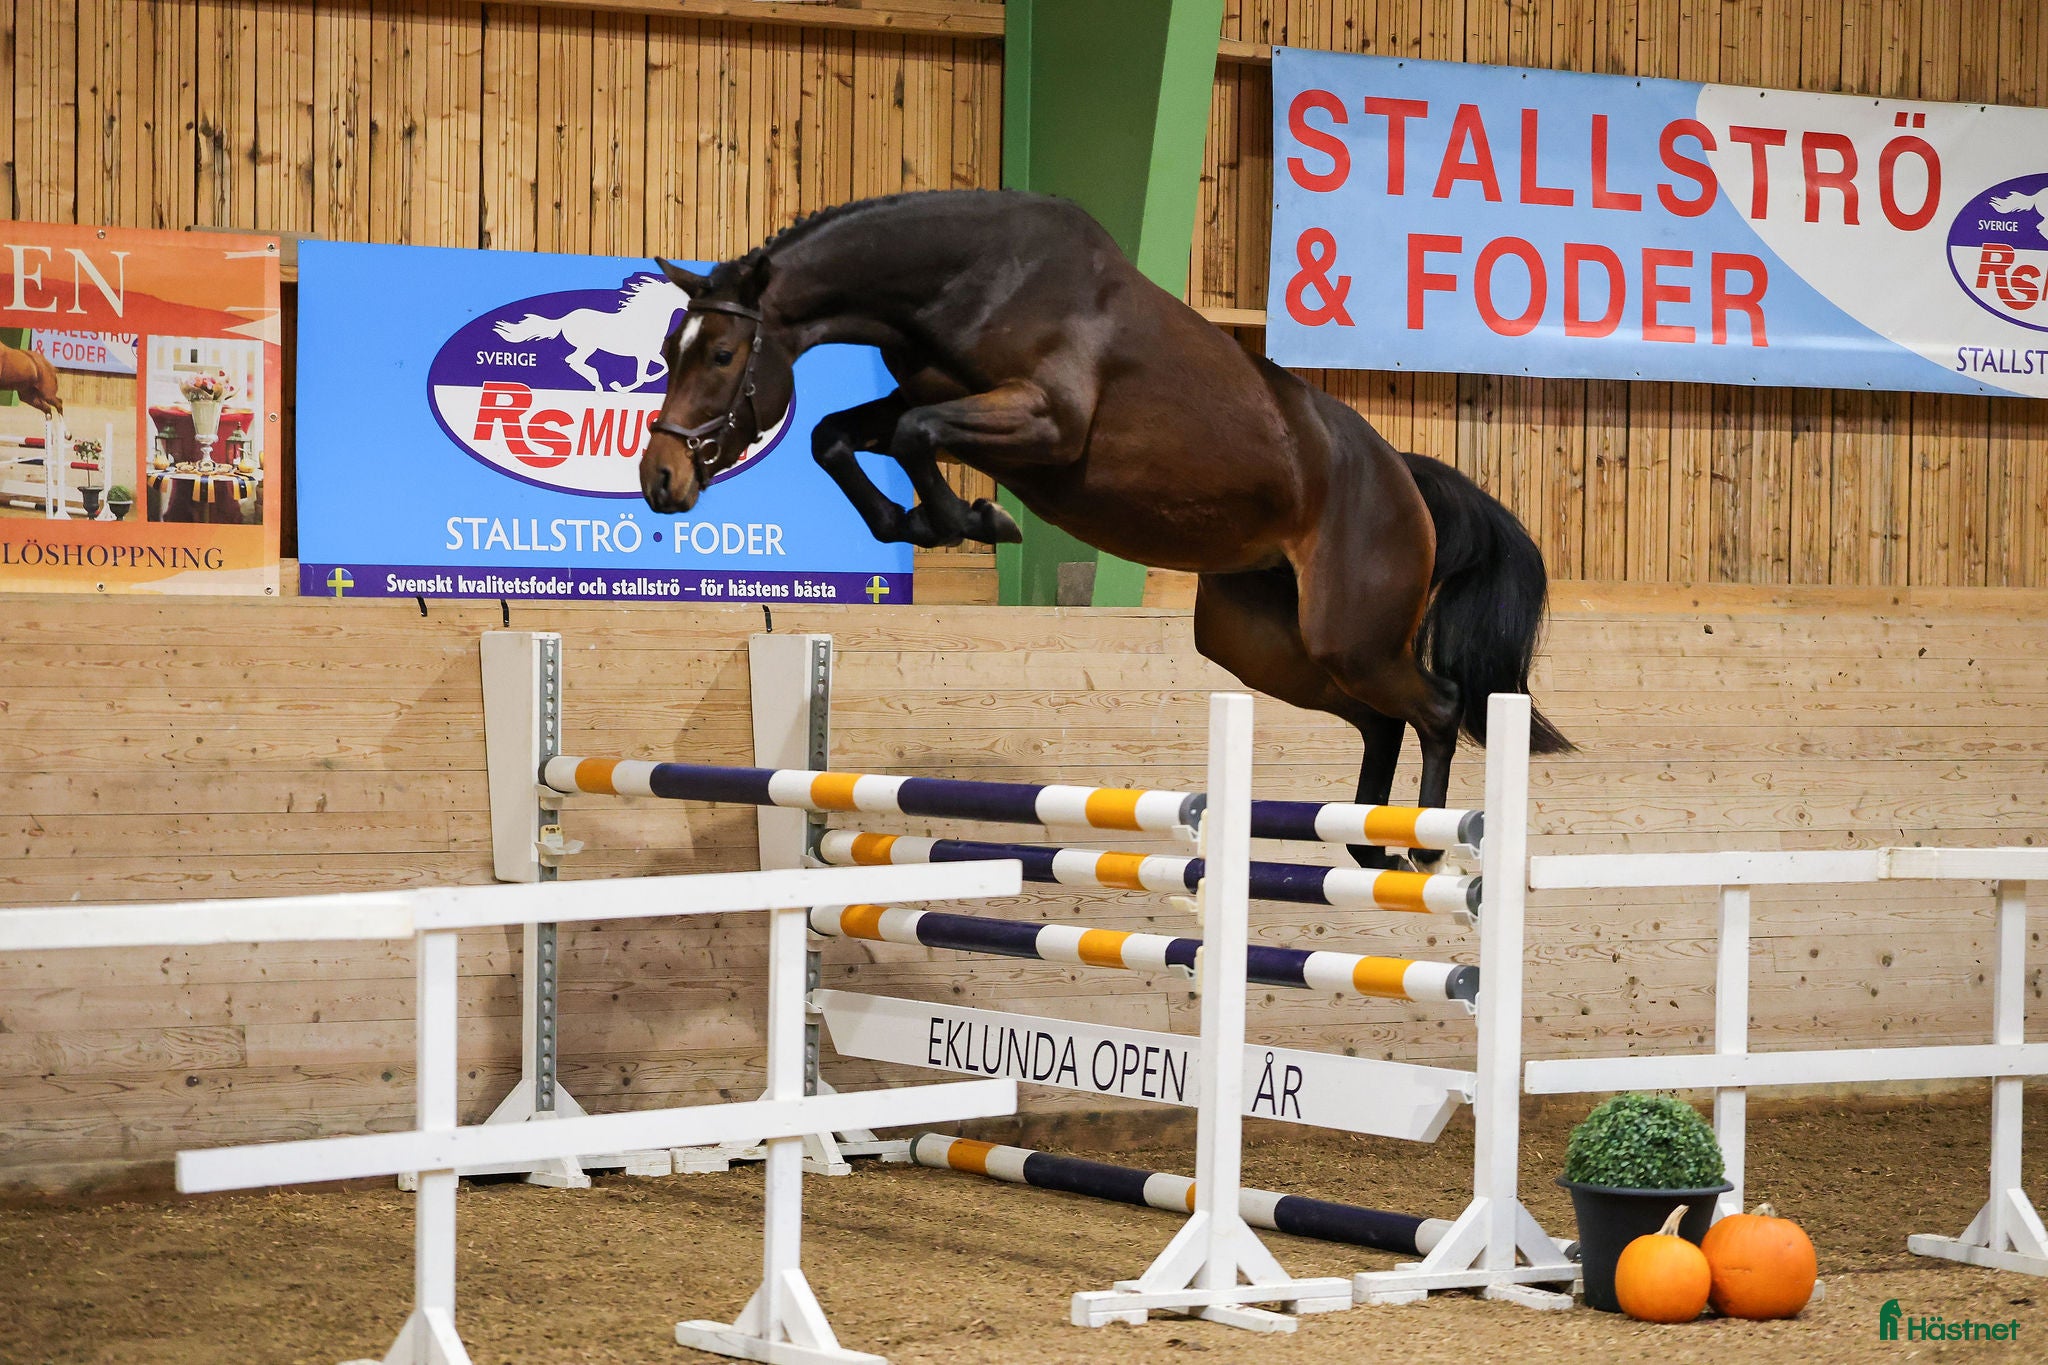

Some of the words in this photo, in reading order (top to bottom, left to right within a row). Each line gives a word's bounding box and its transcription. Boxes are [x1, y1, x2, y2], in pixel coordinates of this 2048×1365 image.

[1286, 88, 1943, 232] STALLSTRÖ
[1977, 219, 2019, 232] SVERIGE
[3, 243, 131, 318] EN
[1284, 226, 1356, 328] &
[1405, 232, 1770, 348] FODER
[52, 341, 107, 363] FODER
[476, 350, 537, 367] SVERIGE
[446, 513, 643, 553] STALLSTRÖ
[674, 521, 786, 556] FODER
[2, 539, 224, 570] LÖSHOPPNING
[386, 573, 453, 593] Svenskt
[457, 575, 574, 595] kvalitetsfoder
[578, 577, 607, 595] och
[612, 578, 680, 596] stallströ
[700, 578, 724, 597] för
[728, 579, 789, 598] hästens
[794, 580, 837, 598] bästa
[927, 1016, 1079, 1087] EKLUNDA
[1092, 1039, 1188, 1102] OPEN
[1251, 1051, 1302, 1119] ÅR
